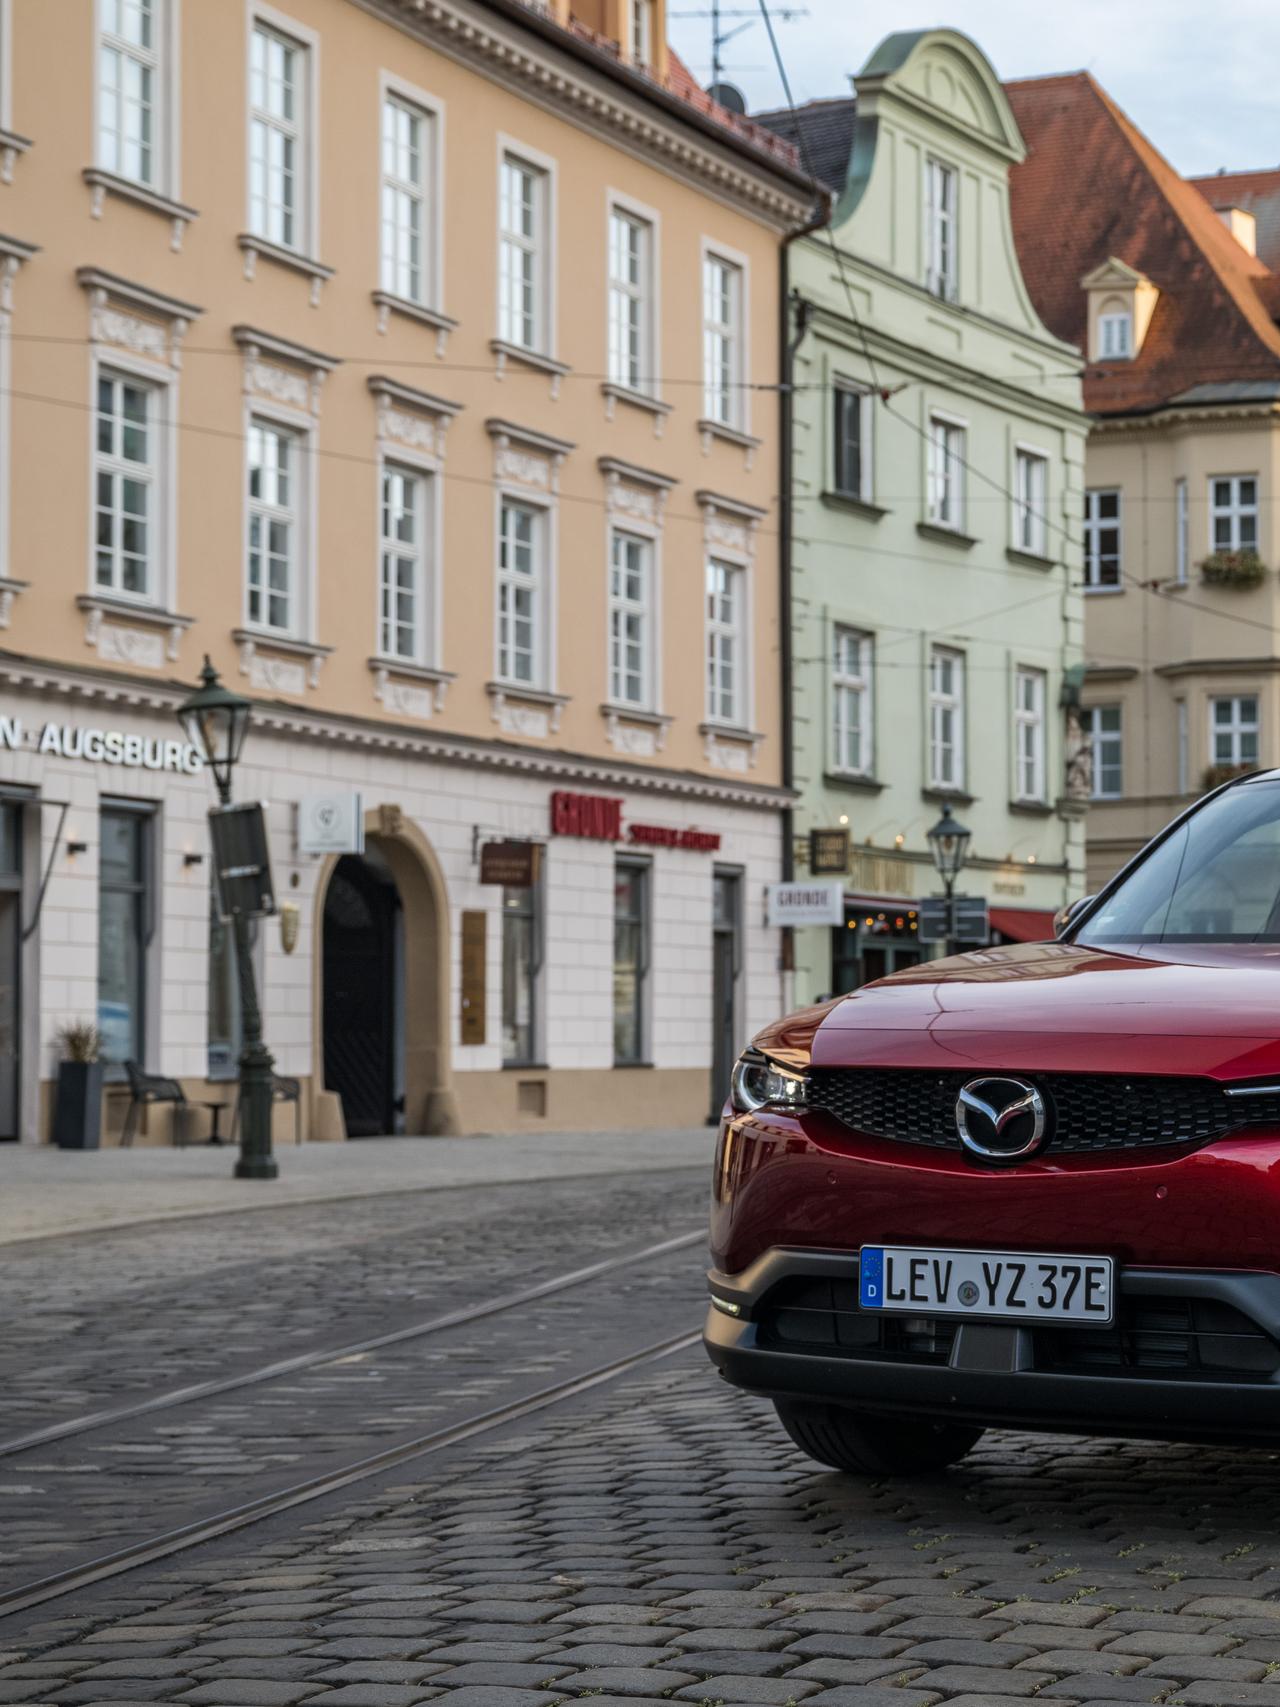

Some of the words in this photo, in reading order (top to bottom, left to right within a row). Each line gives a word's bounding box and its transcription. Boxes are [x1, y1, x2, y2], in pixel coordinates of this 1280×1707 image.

[40, 721, 203, 774] AUGSBURG
[777, 889, 829, 906] GRONDE
[867, 1284, 877, 1298] D
[886, 1256, 953, 1303] LEV
[982, 1261, 1026, 1308] YZ
[1037, 1264, 1106, 1312] 37E
